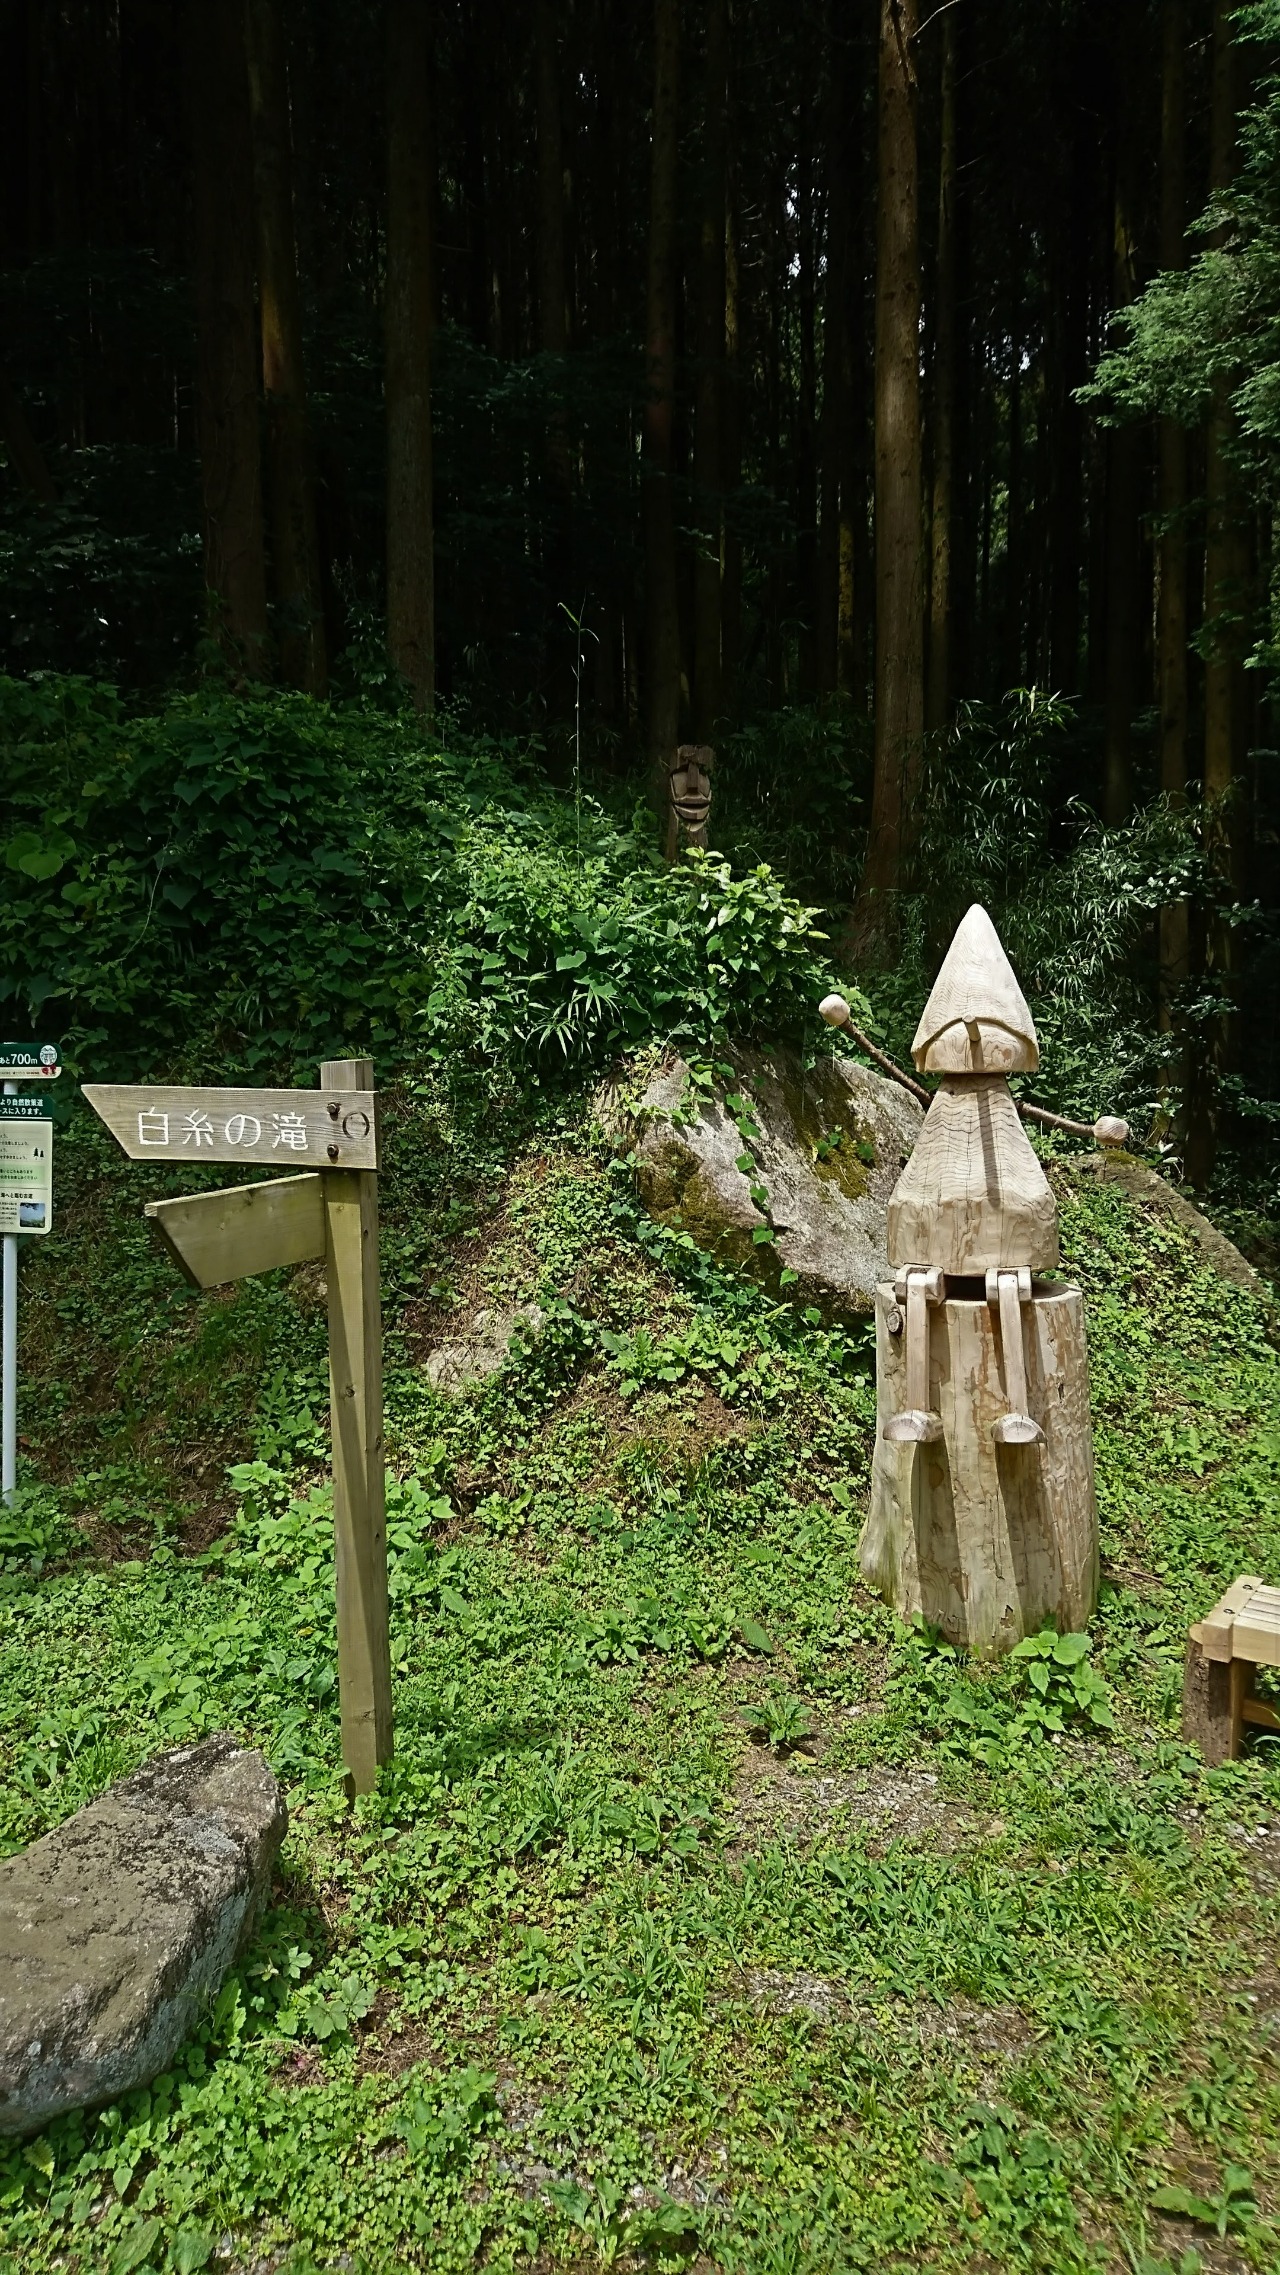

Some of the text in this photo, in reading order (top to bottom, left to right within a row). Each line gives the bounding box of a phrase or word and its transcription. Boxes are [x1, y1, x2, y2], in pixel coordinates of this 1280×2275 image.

[0, 1107, 42, 1116] スに入ります。
[138, 1104, 308, 1151] 白糸の滝
